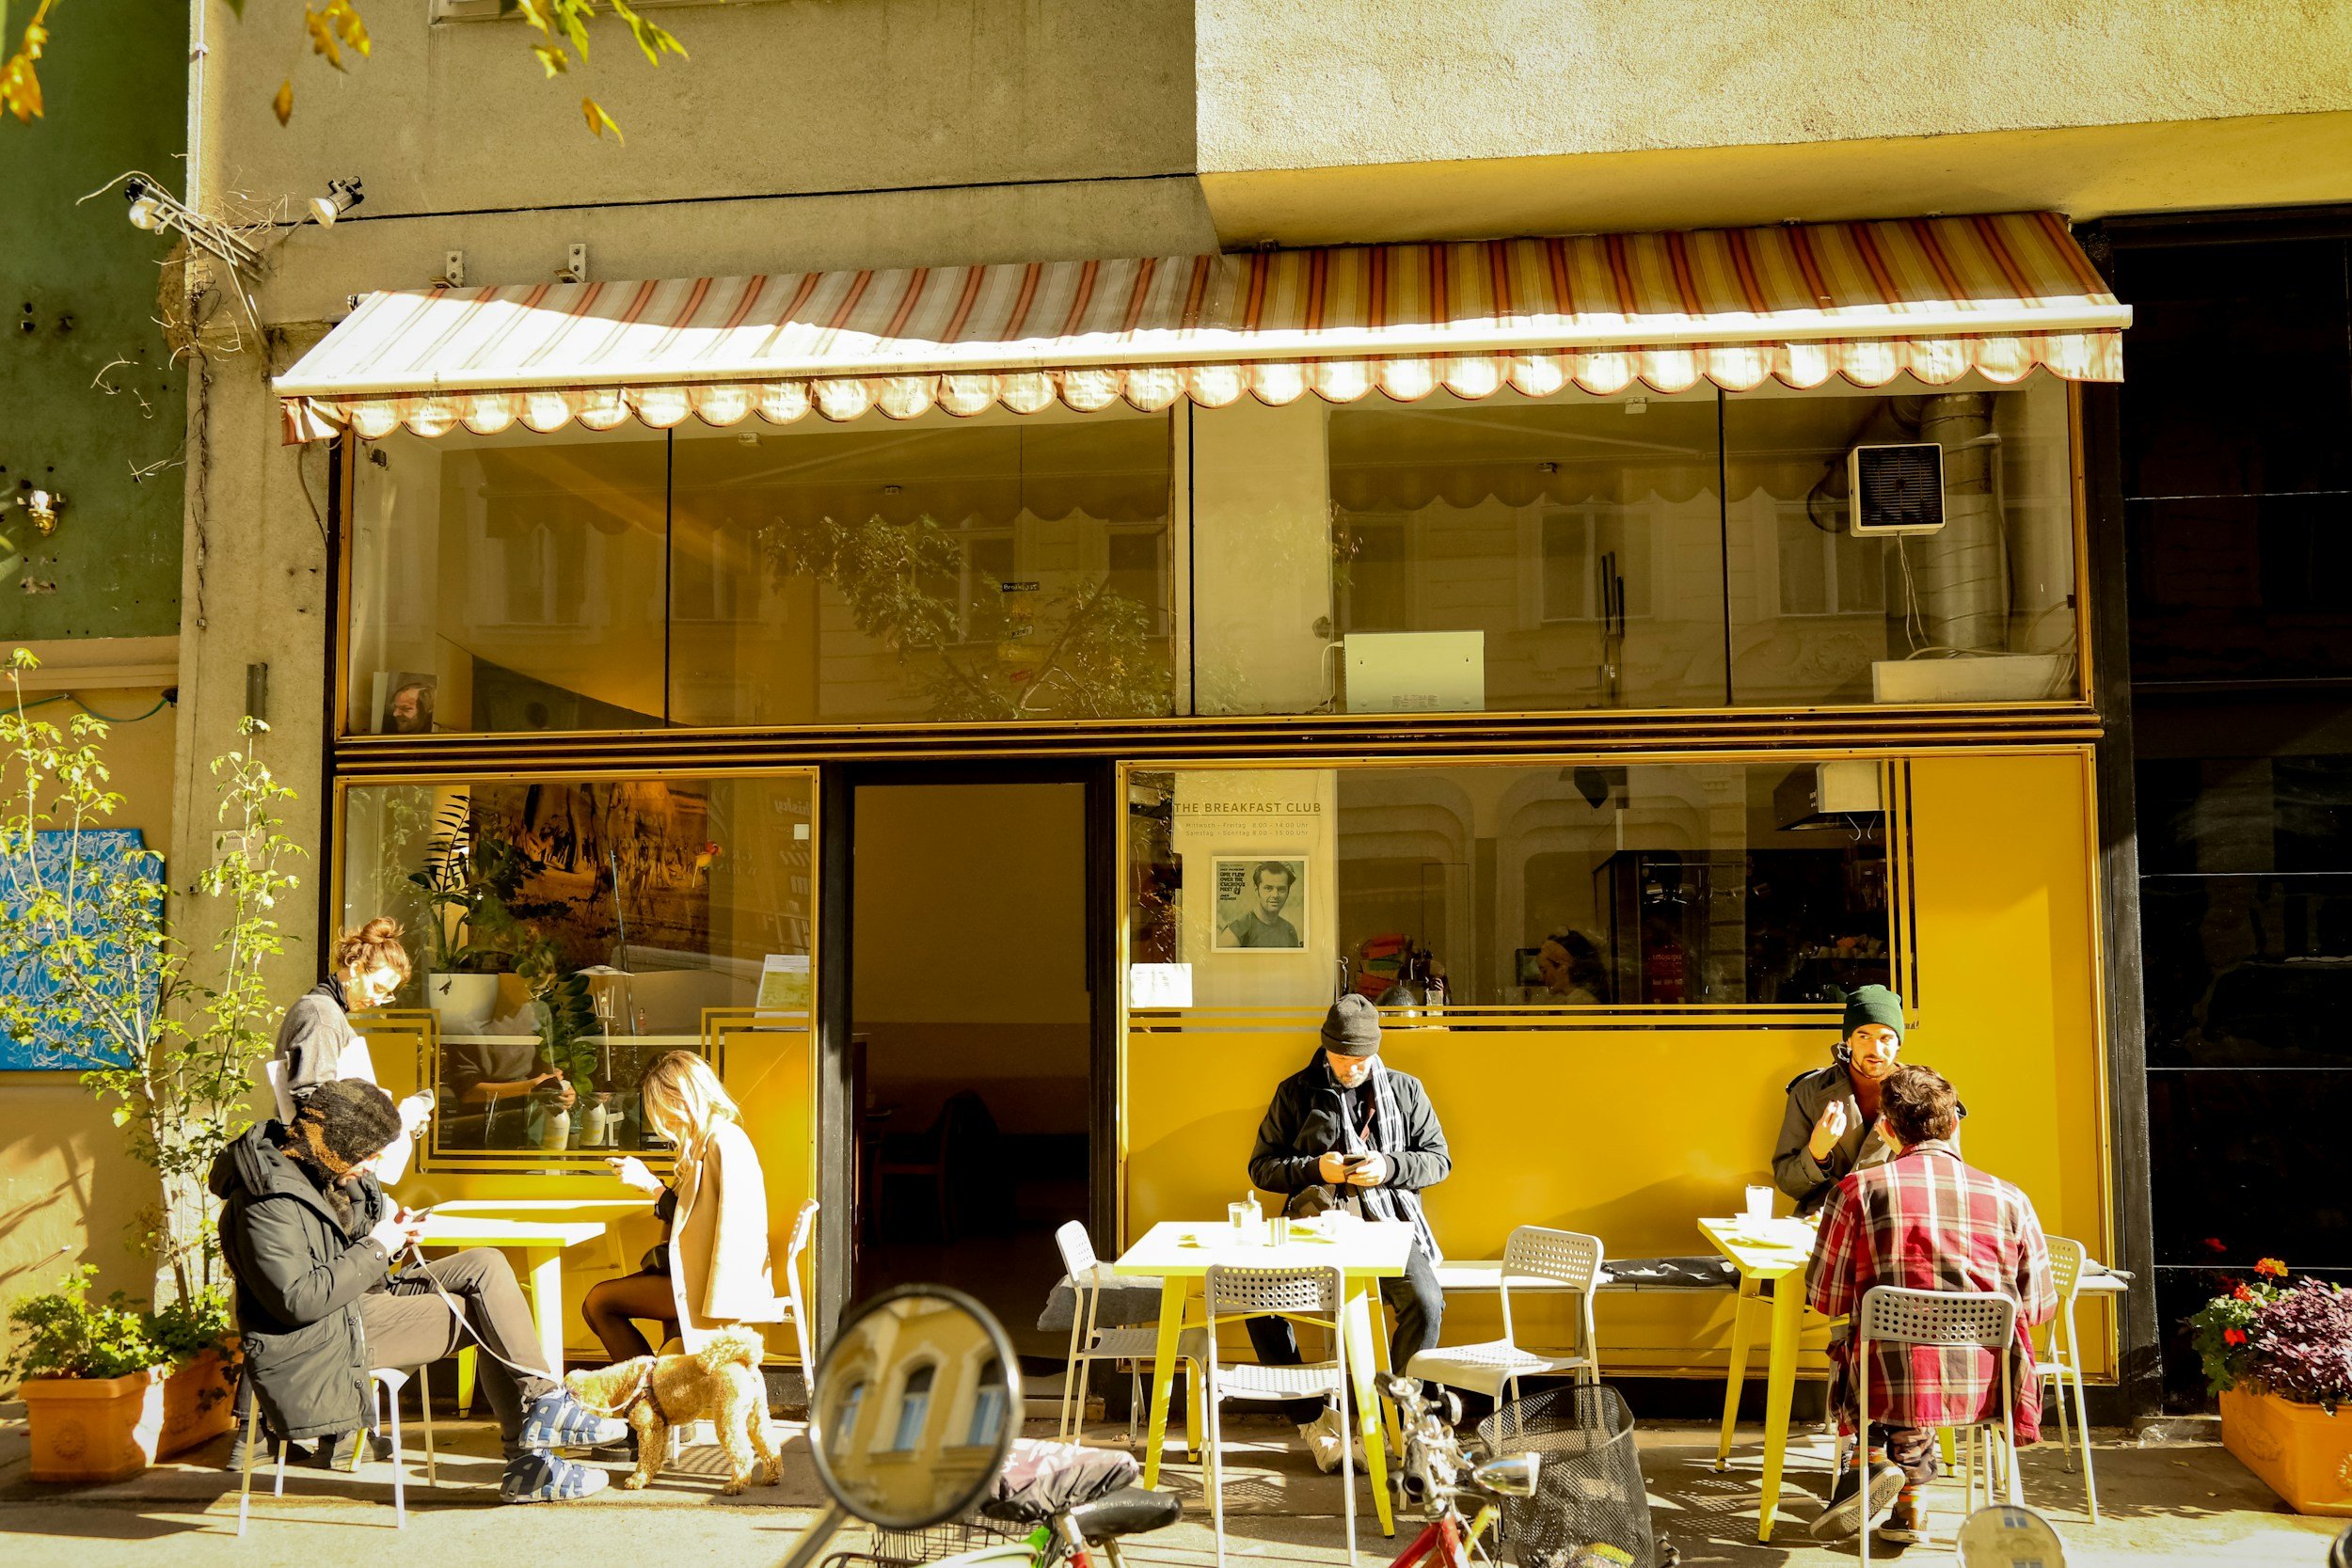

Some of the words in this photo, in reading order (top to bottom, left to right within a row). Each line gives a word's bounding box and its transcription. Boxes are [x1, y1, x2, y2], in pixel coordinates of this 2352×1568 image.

[1175, 802, 1199, 813] THE
[1204, 802, 1281, 813] BREAKFAST
[1286, 802, 1321, 813] CLUB
[518, 1398, 601, 1445] AIR
[502, 1453, 584, 1498] AIR
